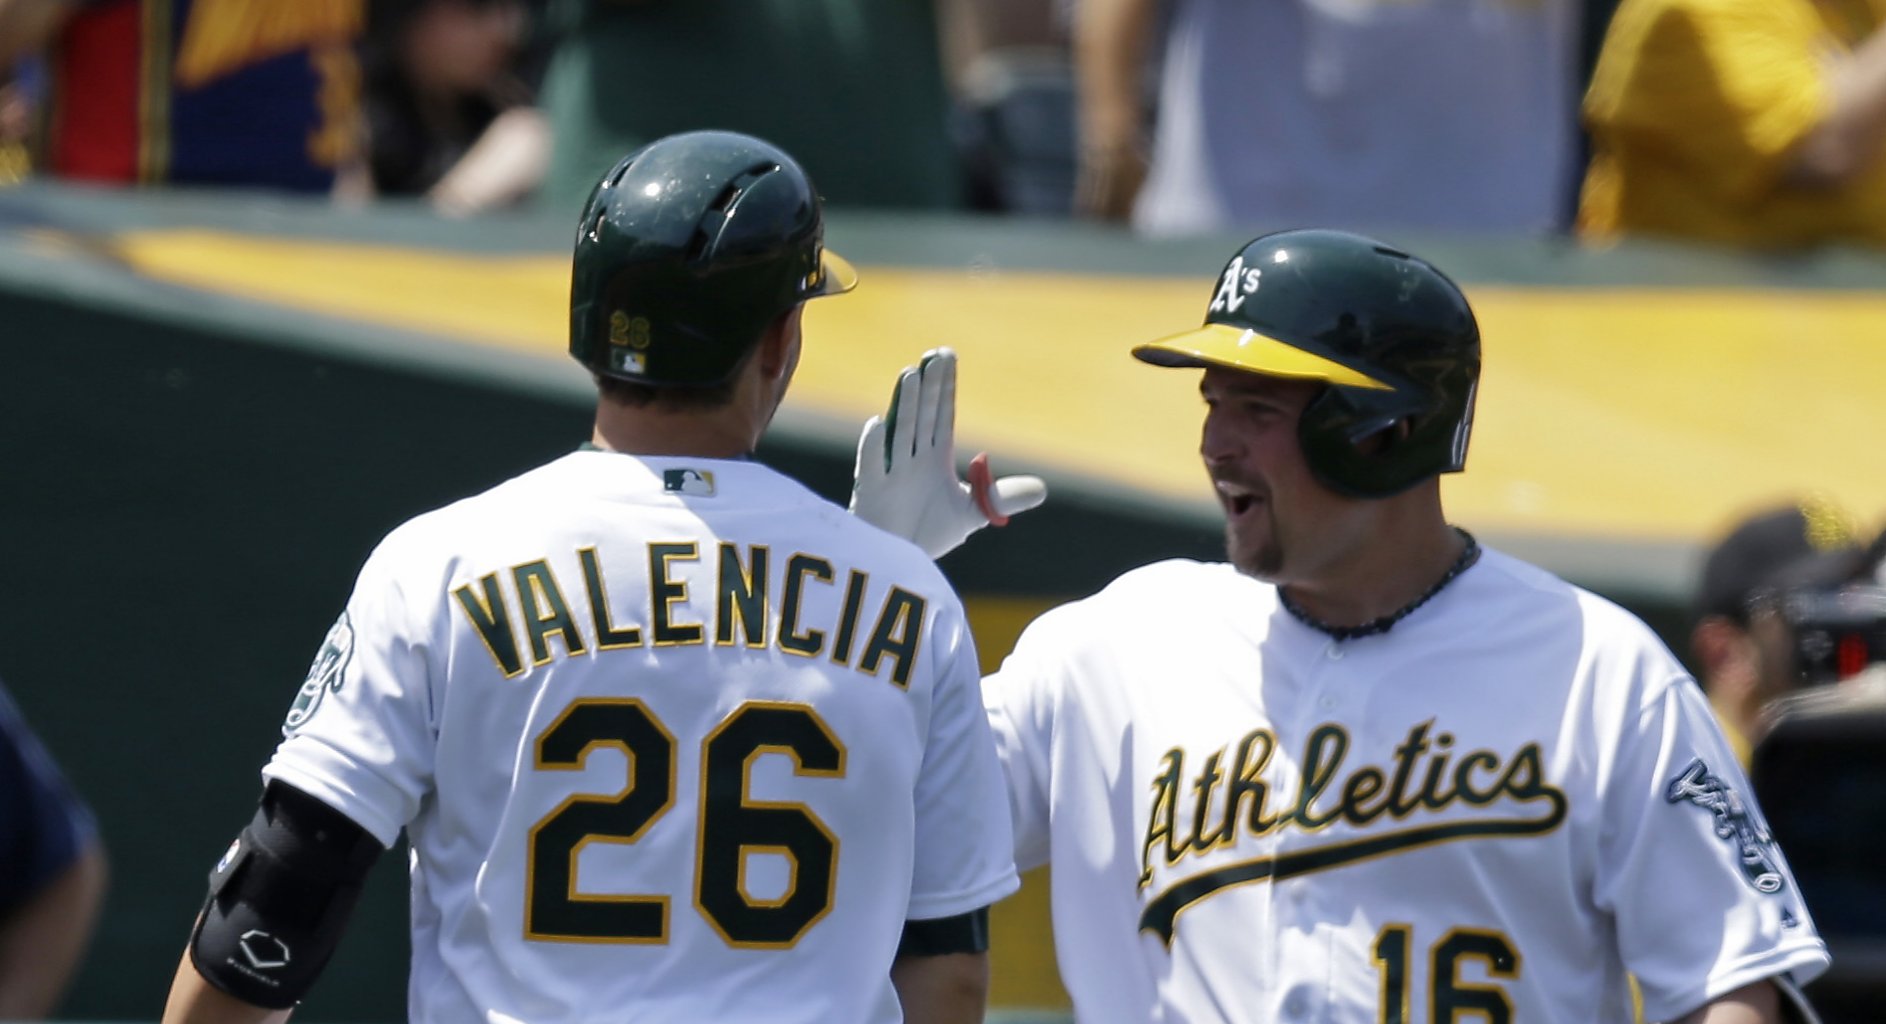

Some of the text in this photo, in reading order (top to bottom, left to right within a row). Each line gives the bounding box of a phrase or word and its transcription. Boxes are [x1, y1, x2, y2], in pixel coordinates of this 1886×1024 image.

[609, 310, 651, 350] 26
[1209, 256, 1262, 313] A's
[449, 540, 928, 691] VALENCIA
[523, 697, 848, 950] 26
[1138, 716, 1567, 897] Athletics
